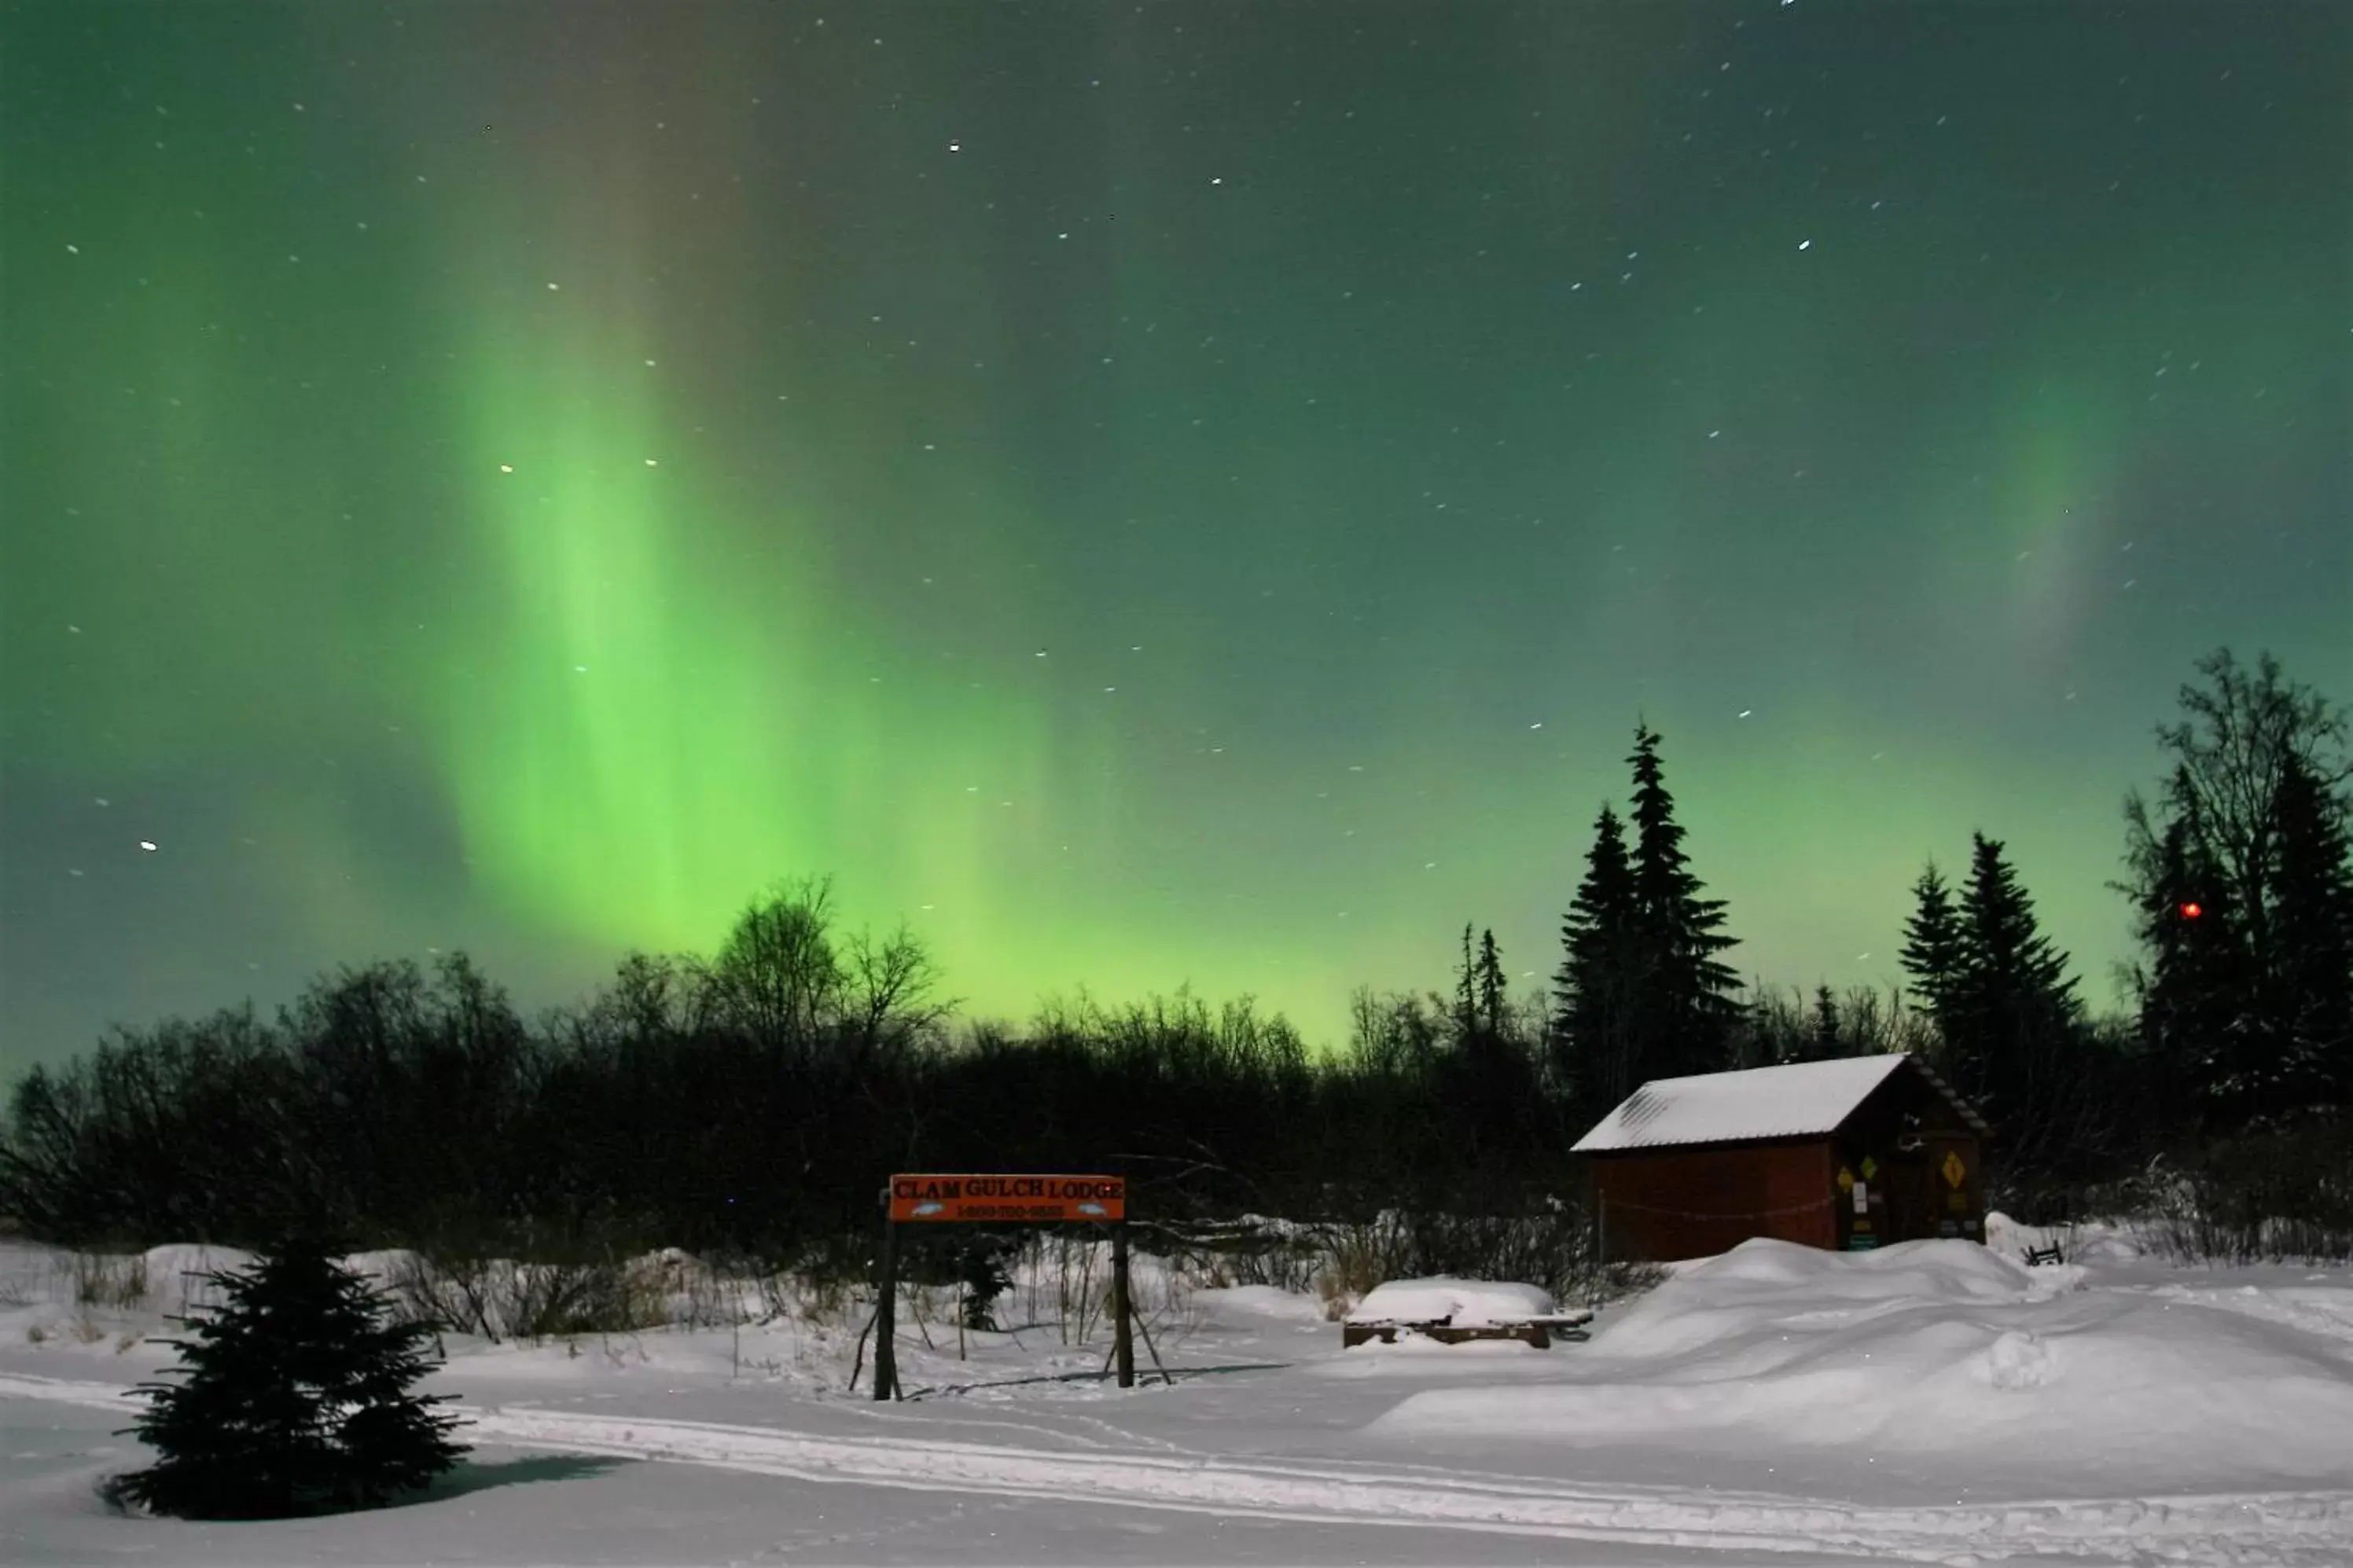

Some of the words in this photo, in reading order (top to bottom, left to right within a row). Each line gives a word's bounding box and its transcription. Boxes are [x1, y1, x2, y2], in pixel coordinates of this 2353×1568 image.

[894, 1180, 961, 1199] CLAM
[966, 1179, 1045, 1197] GULCH
[1050, 1181, 1124, 1199] LODGE
